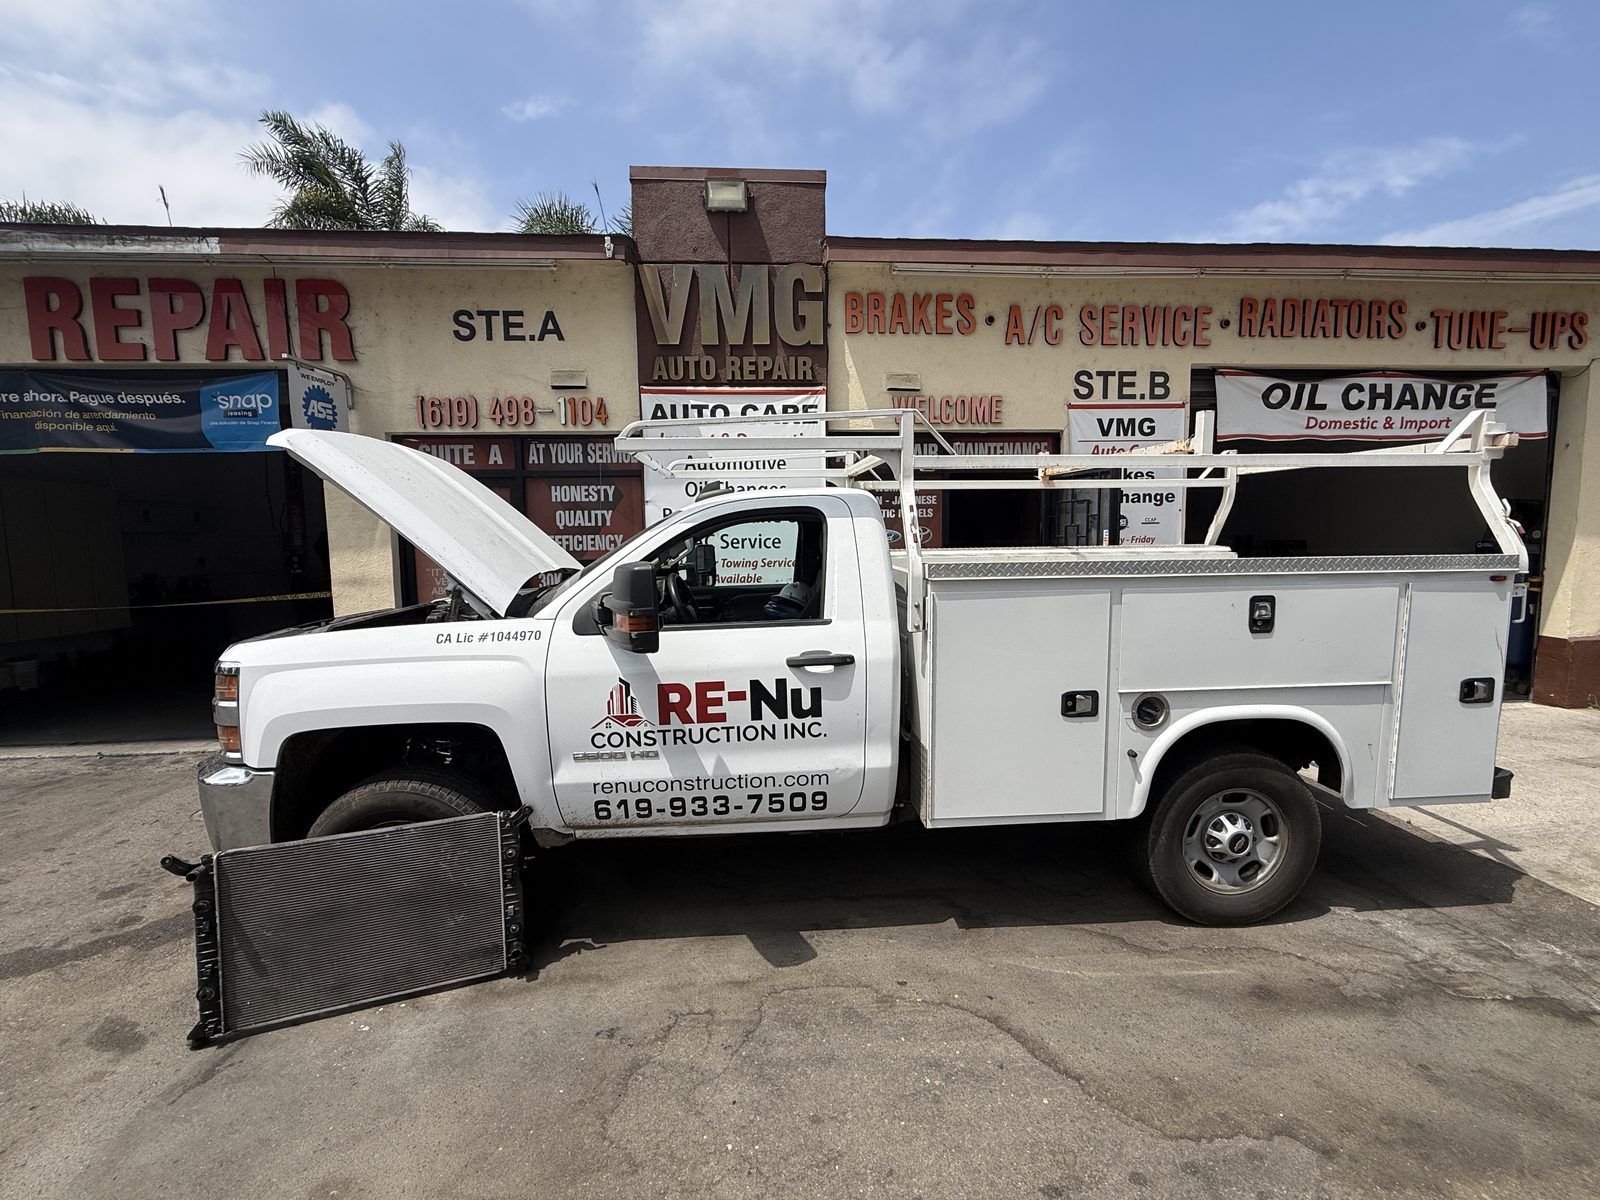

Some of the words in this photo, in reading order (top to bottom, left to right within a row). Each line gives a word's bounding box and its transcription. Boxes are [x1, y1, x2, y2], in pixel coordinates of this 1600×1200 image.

[637, 263, 825, 347] VMG
[22, 277, 358, 361] REPAIR
[452, 309, 566, 342] STE.A
[844, 292, 977, 336] BRAKES
[1005, 303, 1064, 346] A/C
[1078, 304, 1213, 347] SERVICE
[1238, 297, 1409, 340] RADIATORS
[1430, 309, 1589, 351] TUNE-UPS
[652, 354, 716, 381] AUTO
[725, 354, 814, 381] REPAIR
[1073, 370, 1171, 400] STE.B
[69, 391, 116, 407] Pague
[117, 391, 187, 407] después.
[218, 393, 273, 414] snap
[1260, 382, 1328, 411] OIL
[1340, 382, 1499, 411] CHANGE
[0, 408, 62, 419] inanciación
[64, 410, 80, 419] de
[307, 400, 334, 421] ASE
[416, 395, 478, 429] (619)
[488, 396, 609, 427] 498-1104
[651, 403, 731, 421] AUTO
[892, 395, 1004, 425] WELCOME
[34, 420, 94, 432] disponible
[1096, 417, 1157, 438] VMG
[1304, 416, 1379, 431] Domestic
[1383, 416, 1395, 430] &
[1399, 416, 1453, 432] Import
[488, 444, 504, 465] A
[528, 443, 546, 465] AT
[549, 443, 584, 465] YOUR
[551, 485, 616, 502] HONESTY
[1120, 489, 1176, 507] hange
[555, 510, 614, 529] QUALITY
[720, 533, 783, 549] Service
[1130, 535, 1156, 545] Friday
[721, 557, 759, 571] Towing
[435, 633, 452, 644] CA
[456, 632, 474, 643] Lic
[477, 630, 542, 643] #1044970
[656, 678, 823, 726] RE-Nu
[590, 724, 777, 749] CONSTRUCTION
[783, 721, 828, 740] INC.
[592, 772, 830, 795] renuconstruction.com
[593, 791, 829, 821] 619-933-7509
